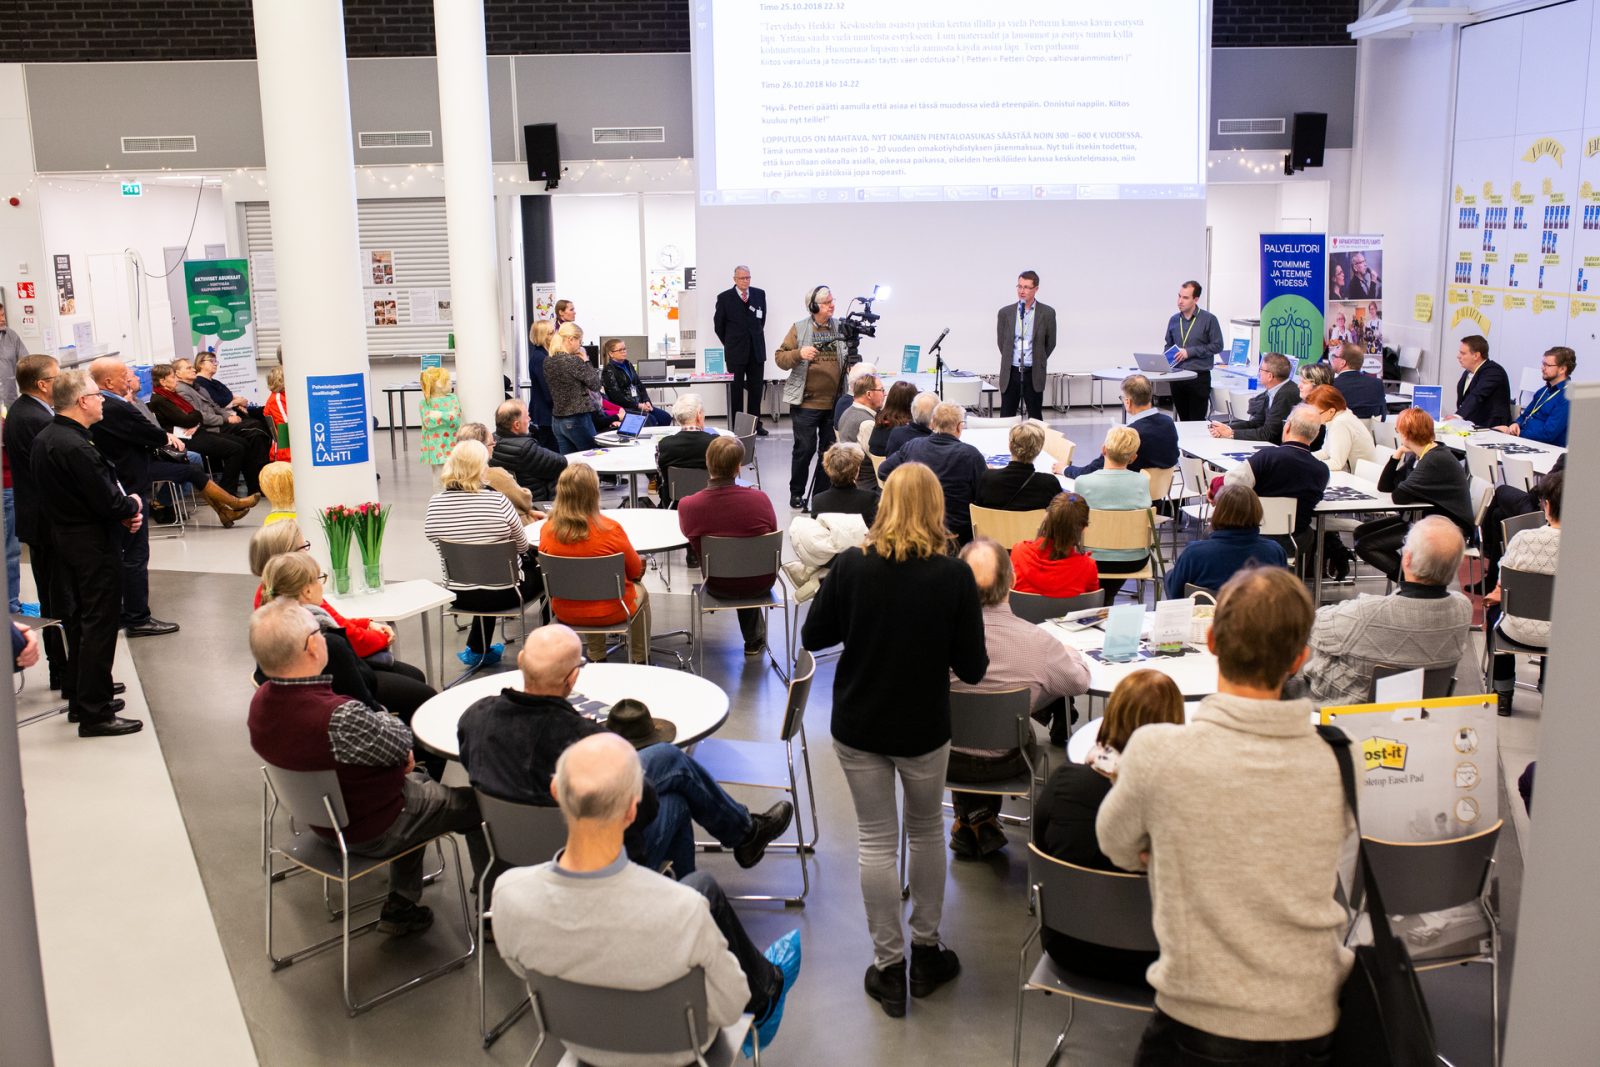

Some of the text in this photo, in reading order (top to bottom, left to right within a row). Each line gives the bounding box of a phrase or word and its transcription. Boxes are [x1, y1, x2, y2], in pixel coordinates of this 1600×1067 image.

[781, 2, 822, 10] 25.10.2018
[782, 80, 823, 88] 26.10.2018
[762, 116, 787, 124] kuuluu
[790, 115, 801, 124] nyt
[762, 135, 812, 143] LOPPUTULOS
[889, 134, 926, 142] JOKAINEN
[928, 133, 995, 141] PIENTALOASUKAS
[997, 132, 1031, 140] SÄÄSTÄÄ
[917, 144, 992, 154] omakotiyhdistyksen
[1046, 143, 1060, 152] Nyt
[854, 168, 870, 177] jopa
[1264, 244, 1320, 253] PALVELUTORI
[1272, 260, 1310, 268] TOIMIMME
[1281, 270, 1312, 278] TEEMME
[1274, 278, 1308, 287] YHDESSÄ
[316, 450, 350, 462] LAHTI
[1364, 746, 1402, 761] ost-it
[1388, 776, 1408, 784] Easel
[1410, 774, 1424, 783] Pad
